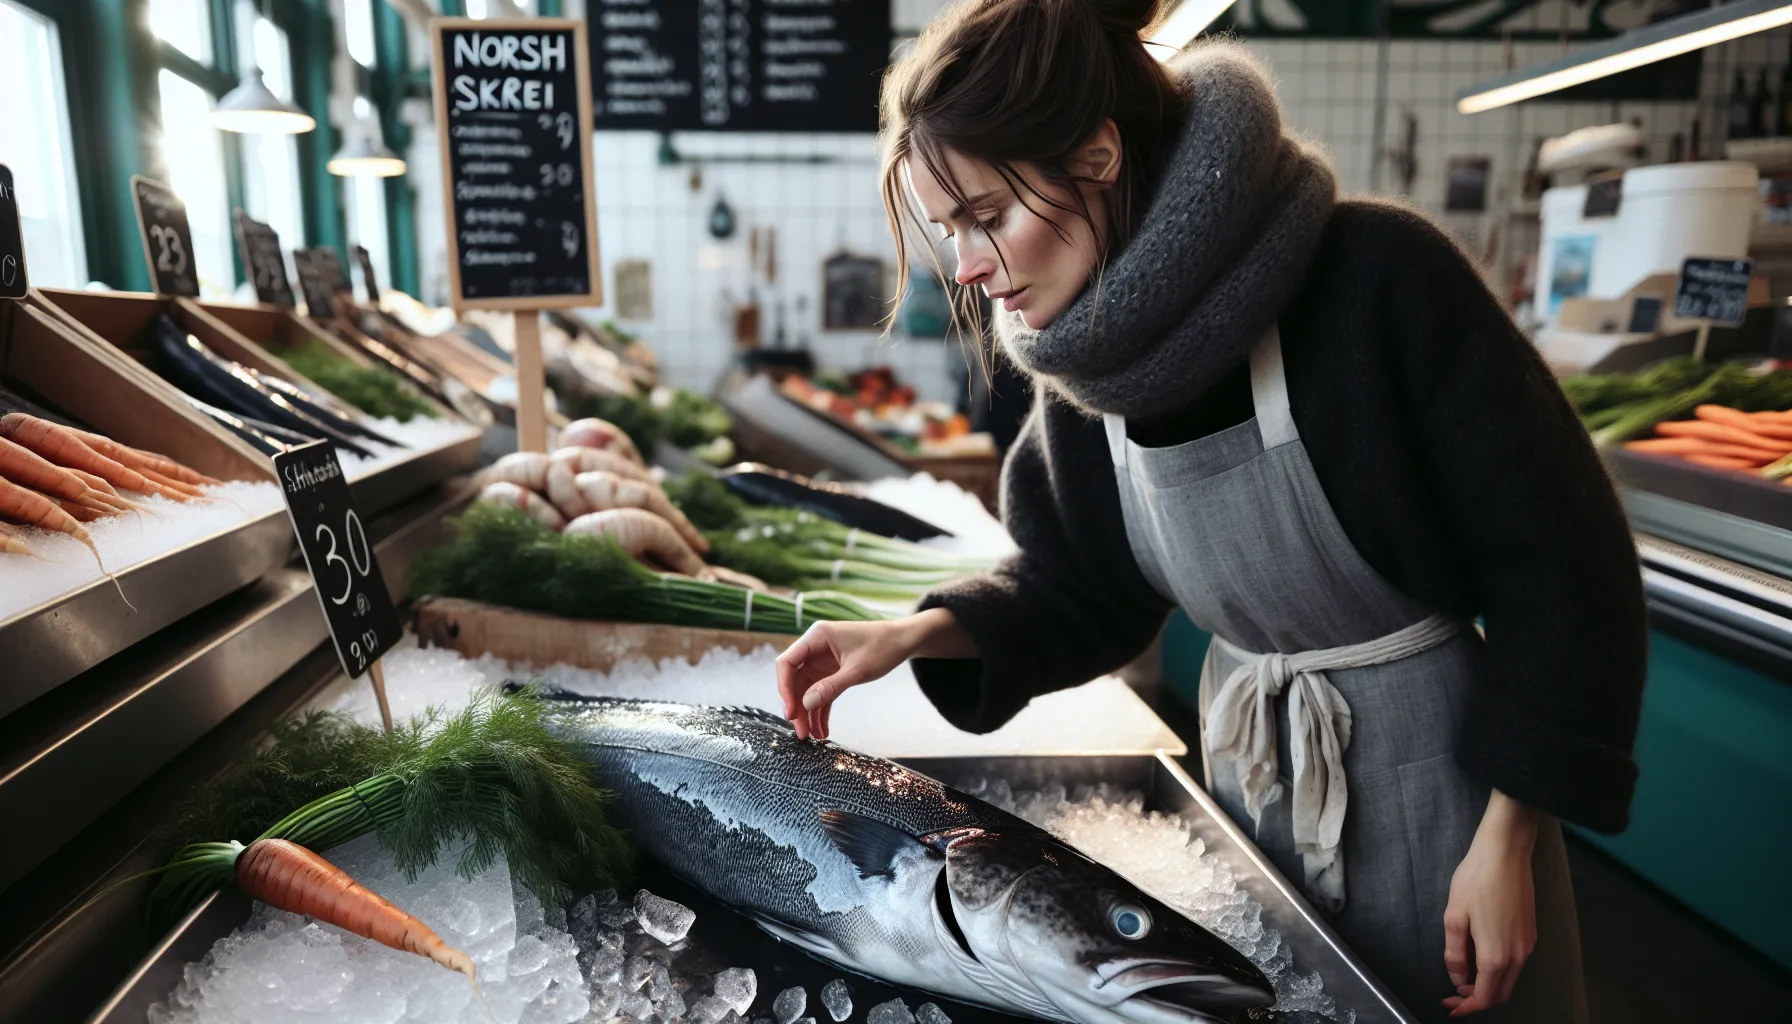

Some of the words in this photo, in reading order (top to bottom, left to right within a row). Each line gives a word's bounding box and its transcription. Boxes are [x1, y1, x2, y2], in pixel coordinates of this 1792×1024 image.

[454, 32, 566, 72] NORSH
[453, 75, 554, 111] SKREI
[316, 509, 371, 605] 30
